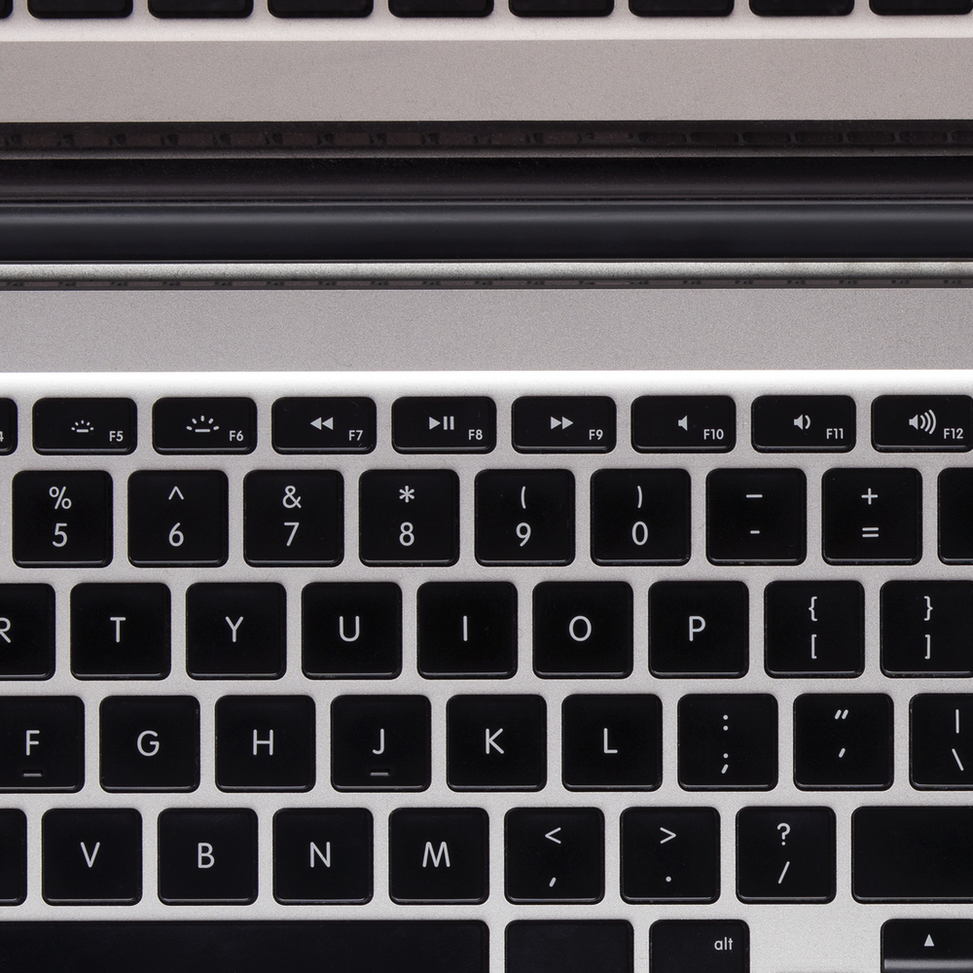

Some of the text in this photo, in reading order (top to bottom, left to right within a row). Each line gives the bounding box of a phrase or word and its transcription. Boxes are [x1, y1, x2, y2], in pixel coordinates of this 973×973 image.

[109, 430, 124, 442] F5
[229, 430, 244, 442] F6
[348, 429, 364, 441] F7
[468, 428, 483, 441] F8
[588, 428, 604, 441] F9
[703, 428, 724, 440] F10
[826, 427, 845, 440] F11
[943, 427, 964, 440] F12
[48, 485, 72, 510] %
[282, 485, 302, 509] &
[520, 485, 527, 509] (
[637, 485, 643, 509] )
[861, 487, 879, 505] +
[52, 522, 68, 548] 5
[168, 522, 184, 547] 6
[283, 521, 300, 547] 7
[399, 521, 415, 547] 8
[515, 522, 532, 547] 9
[631, 521, 649, 546] 0
[861, 526, 880, 538] =
[808, 596, 818, 622] {
[923, 595, 934, 621] }
[0, 616, 12, 644] R
[109, 616, 127, 643] T
[225, 616, 244, 643] Y
[339, 615, 360, 642] U
[462, 615, 468, 642] I
[568, 615, 592, 642] O
[688, 615, 706, 642] P
[810, 633, 818, 660] [
[924, 634, 931, 660] ]
[722, 713, 729, 731] :
[25, 729, 40, 756] F
[136, 730, 160, 757] G
[252, 729, 274, 756] H
[372, 728, 385, 755] J
[485, 727, 505, 755] K
[603, 727, 619, 754] L
[721, 752, 729, 774] ;
[951, 748, 964, 772] \
[544, 827, 562, 844] <
[659, 826, 677, 844] >
[776, 822, 791, 846] ?
[80, 841, 101, 868] V
[197, 842, 215, 869] B
[309, 841, 331, 868] N
[422, 841, 451, 868] M
[777, 860, 790, 884] /
[713, 936, 734, 951] alt
